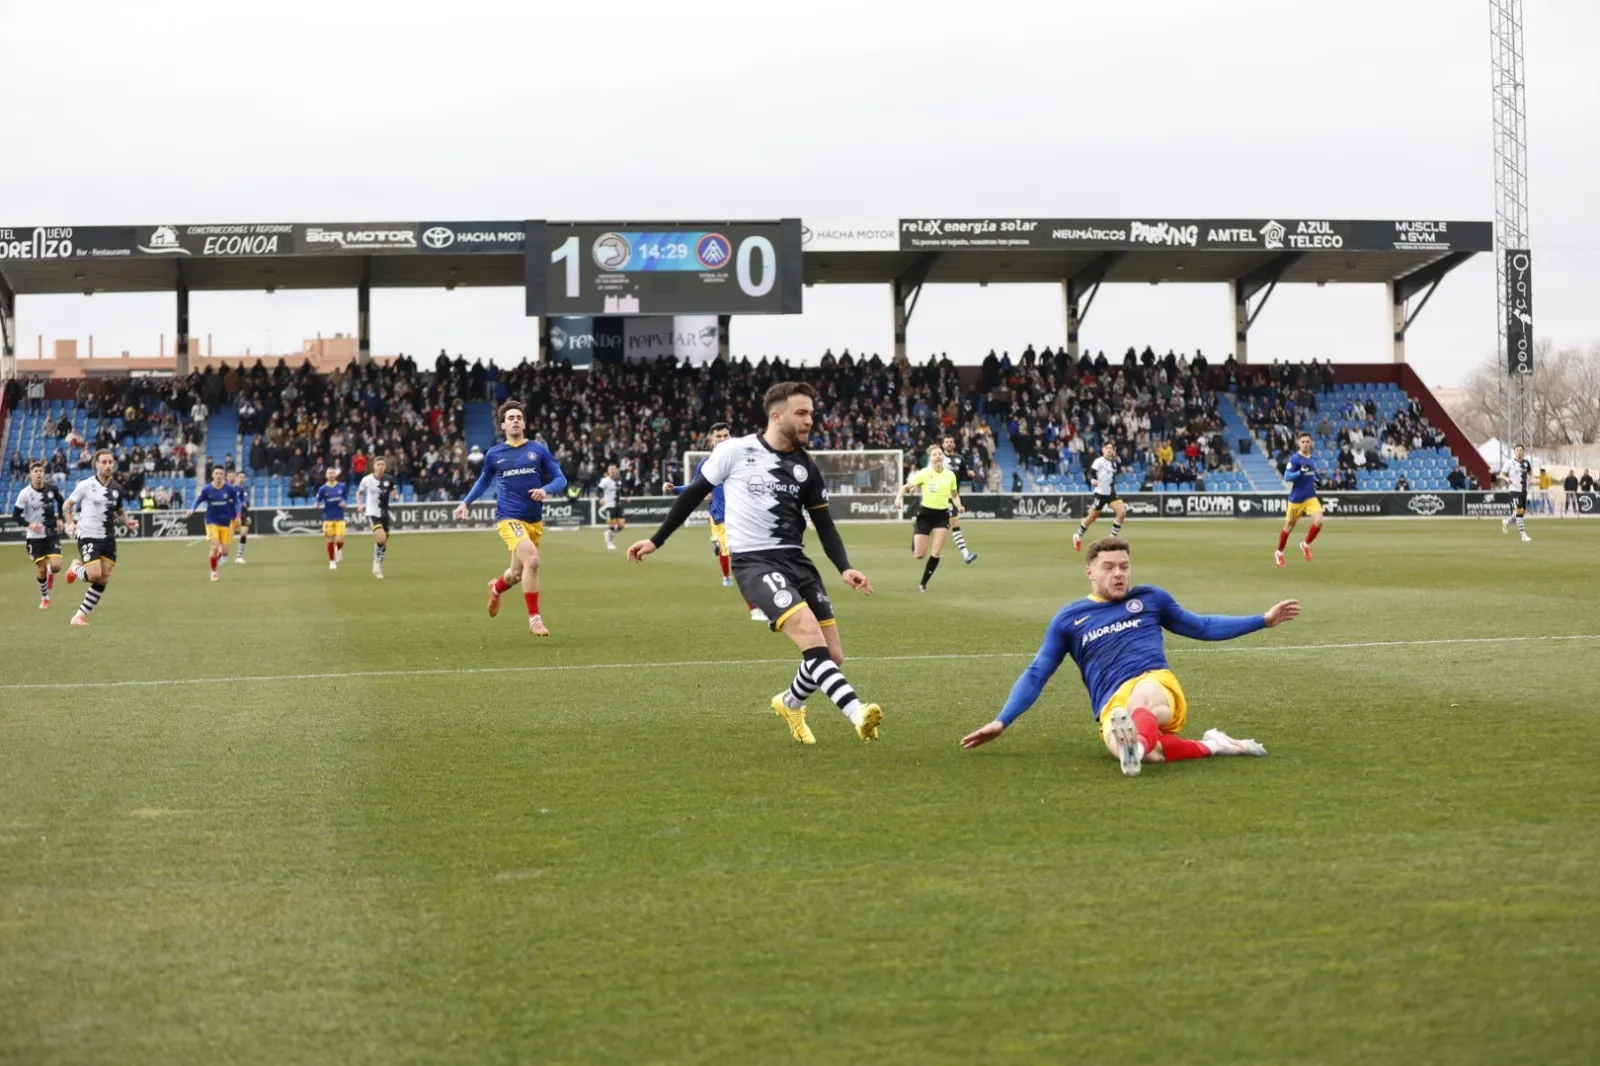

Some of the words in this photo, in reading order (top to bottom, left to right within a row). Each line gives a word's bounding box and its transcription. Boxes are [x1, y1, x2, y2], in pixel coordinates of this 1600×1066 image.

[943, 219, 997, 234] energía
[1000, 219, 1038, 232] solar
[1297, 221, 1334, 234] AZUL
[1395, 221, 1447, 232] MUSCLE
[347, 230, 417, 246] MOTOR
[457, 232, 496, 242] HACHA
[816, 230, 855, 239] HACHA
[857, 230, 895, 239] MOTOR
[1052, 227, 1125, 240] NEUMÁTICOS
[1129, 221, 1198, 247] PARKING
[1207, 228, 1257, 242] AMTEL
[1408, 232, 1435, 242] GYM
[203, 235, 278, 255] ECONOA
[1288, 235, 1343, 248] TELECO
[638, 243, 688, 259] 14:29
[550, 236, 580, 298] 1
[736, 235, 776, 297] 0
[569, 333, 622, 350] FONDO
[401, 509, 419, 522] DE
[423, 508, 448, 521] LOS
[82, 543, 93, 555] 22
[762, 571, 786, 593] 19
